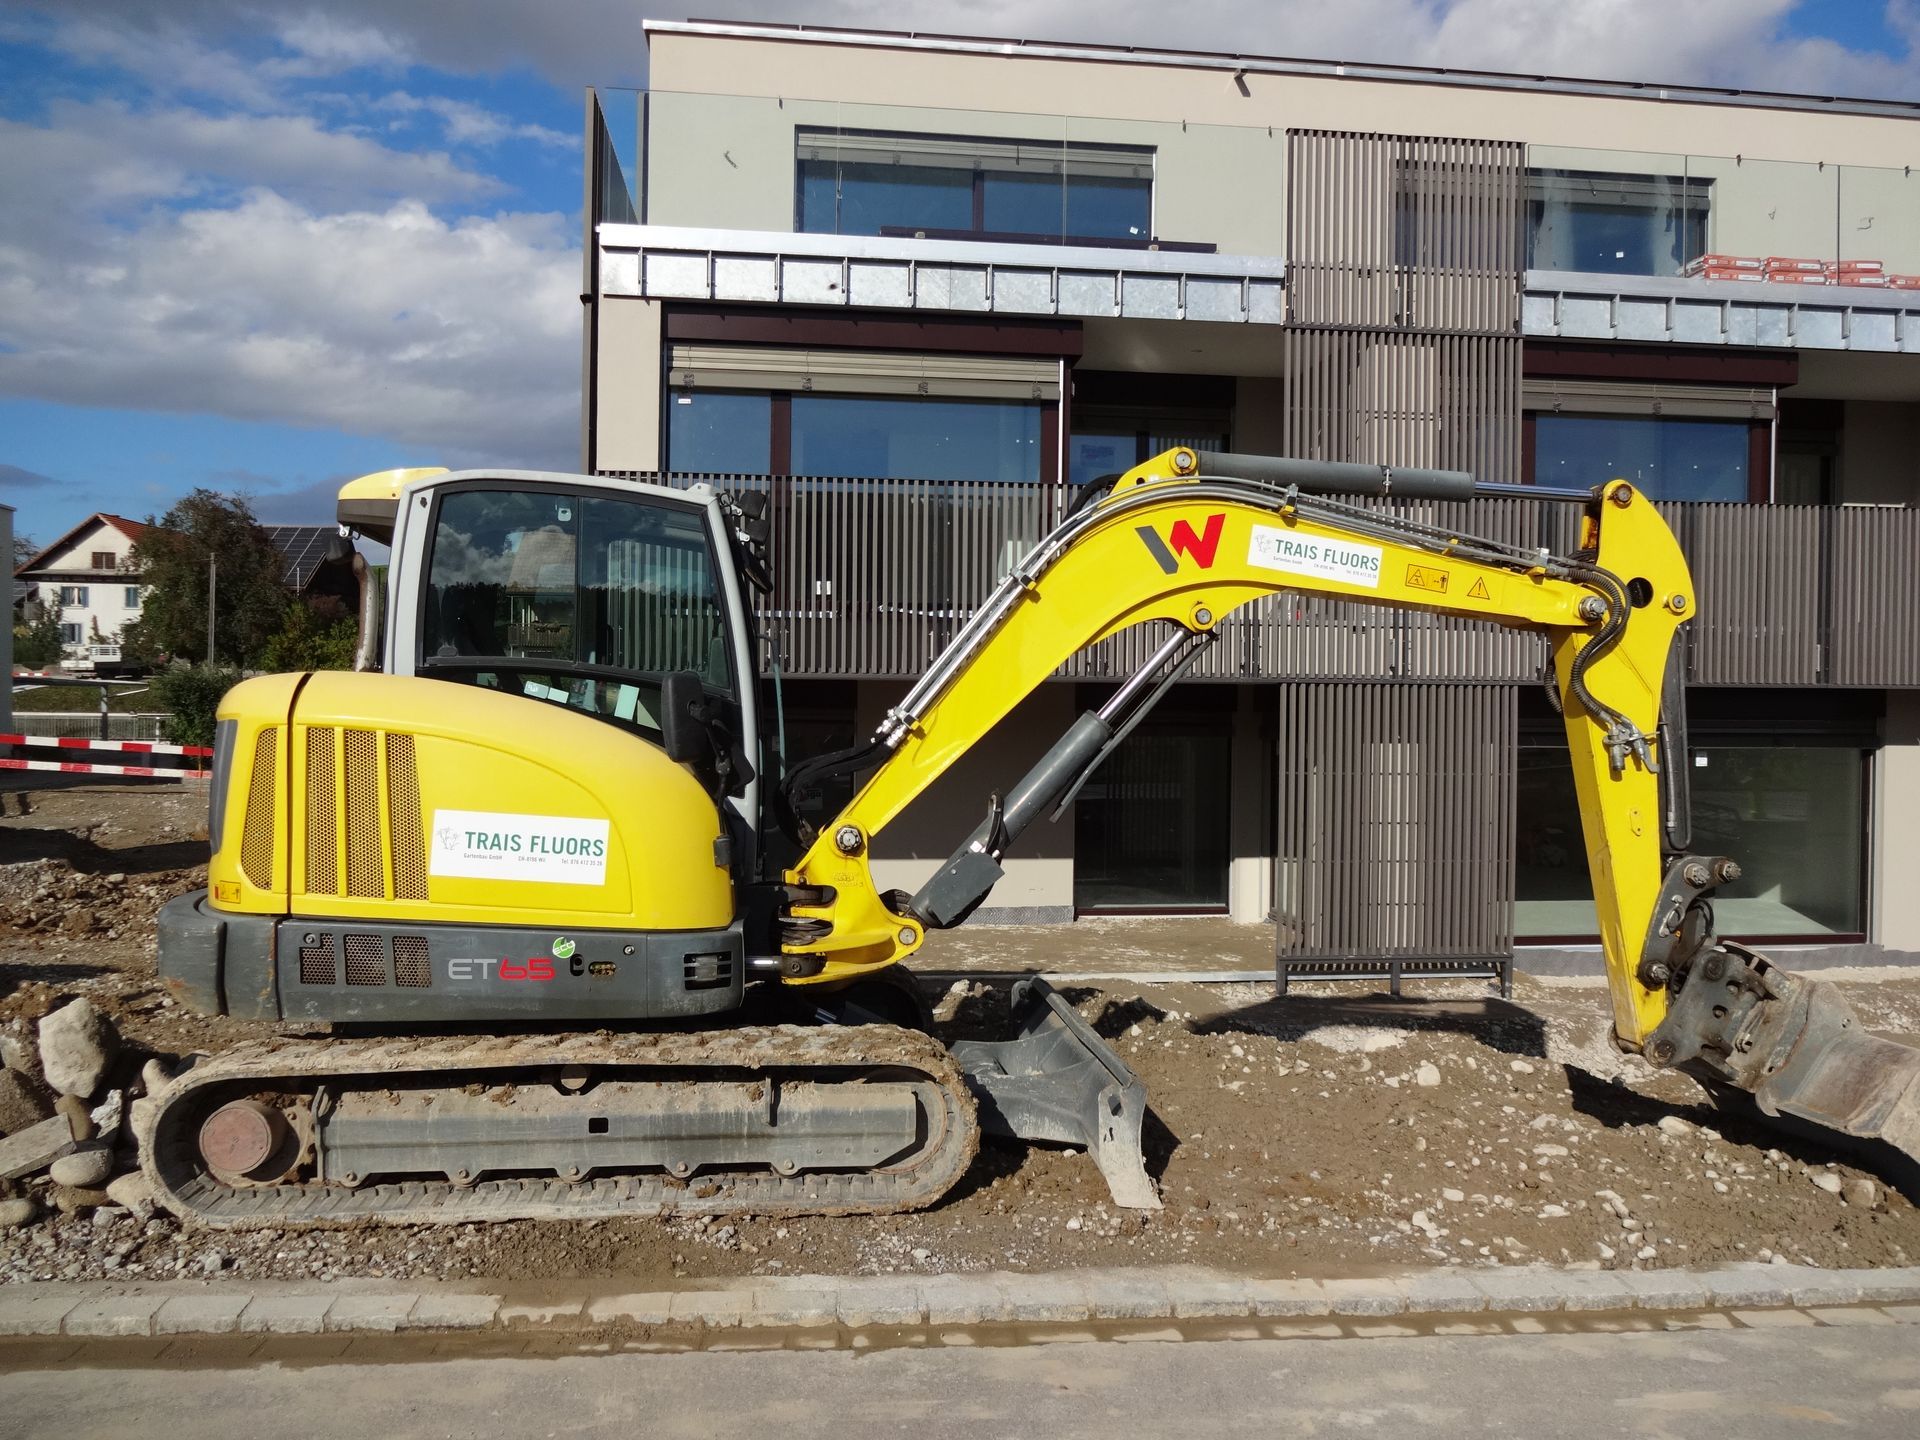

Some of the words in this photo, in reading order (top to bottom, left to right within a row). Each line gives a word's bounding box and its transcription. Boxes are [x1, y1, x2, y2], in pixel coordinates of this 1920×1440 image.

[1275, 539, 1318, 560] TRAIS
[1323, 548, 1379, 572] FLUORS
[465, 831, 522, 852] TRAIS
[530, 835, 604, 856] FLUORS
[463, 852, 488, 860] Gartenbau
[552, 940, 576, 956] ECO
